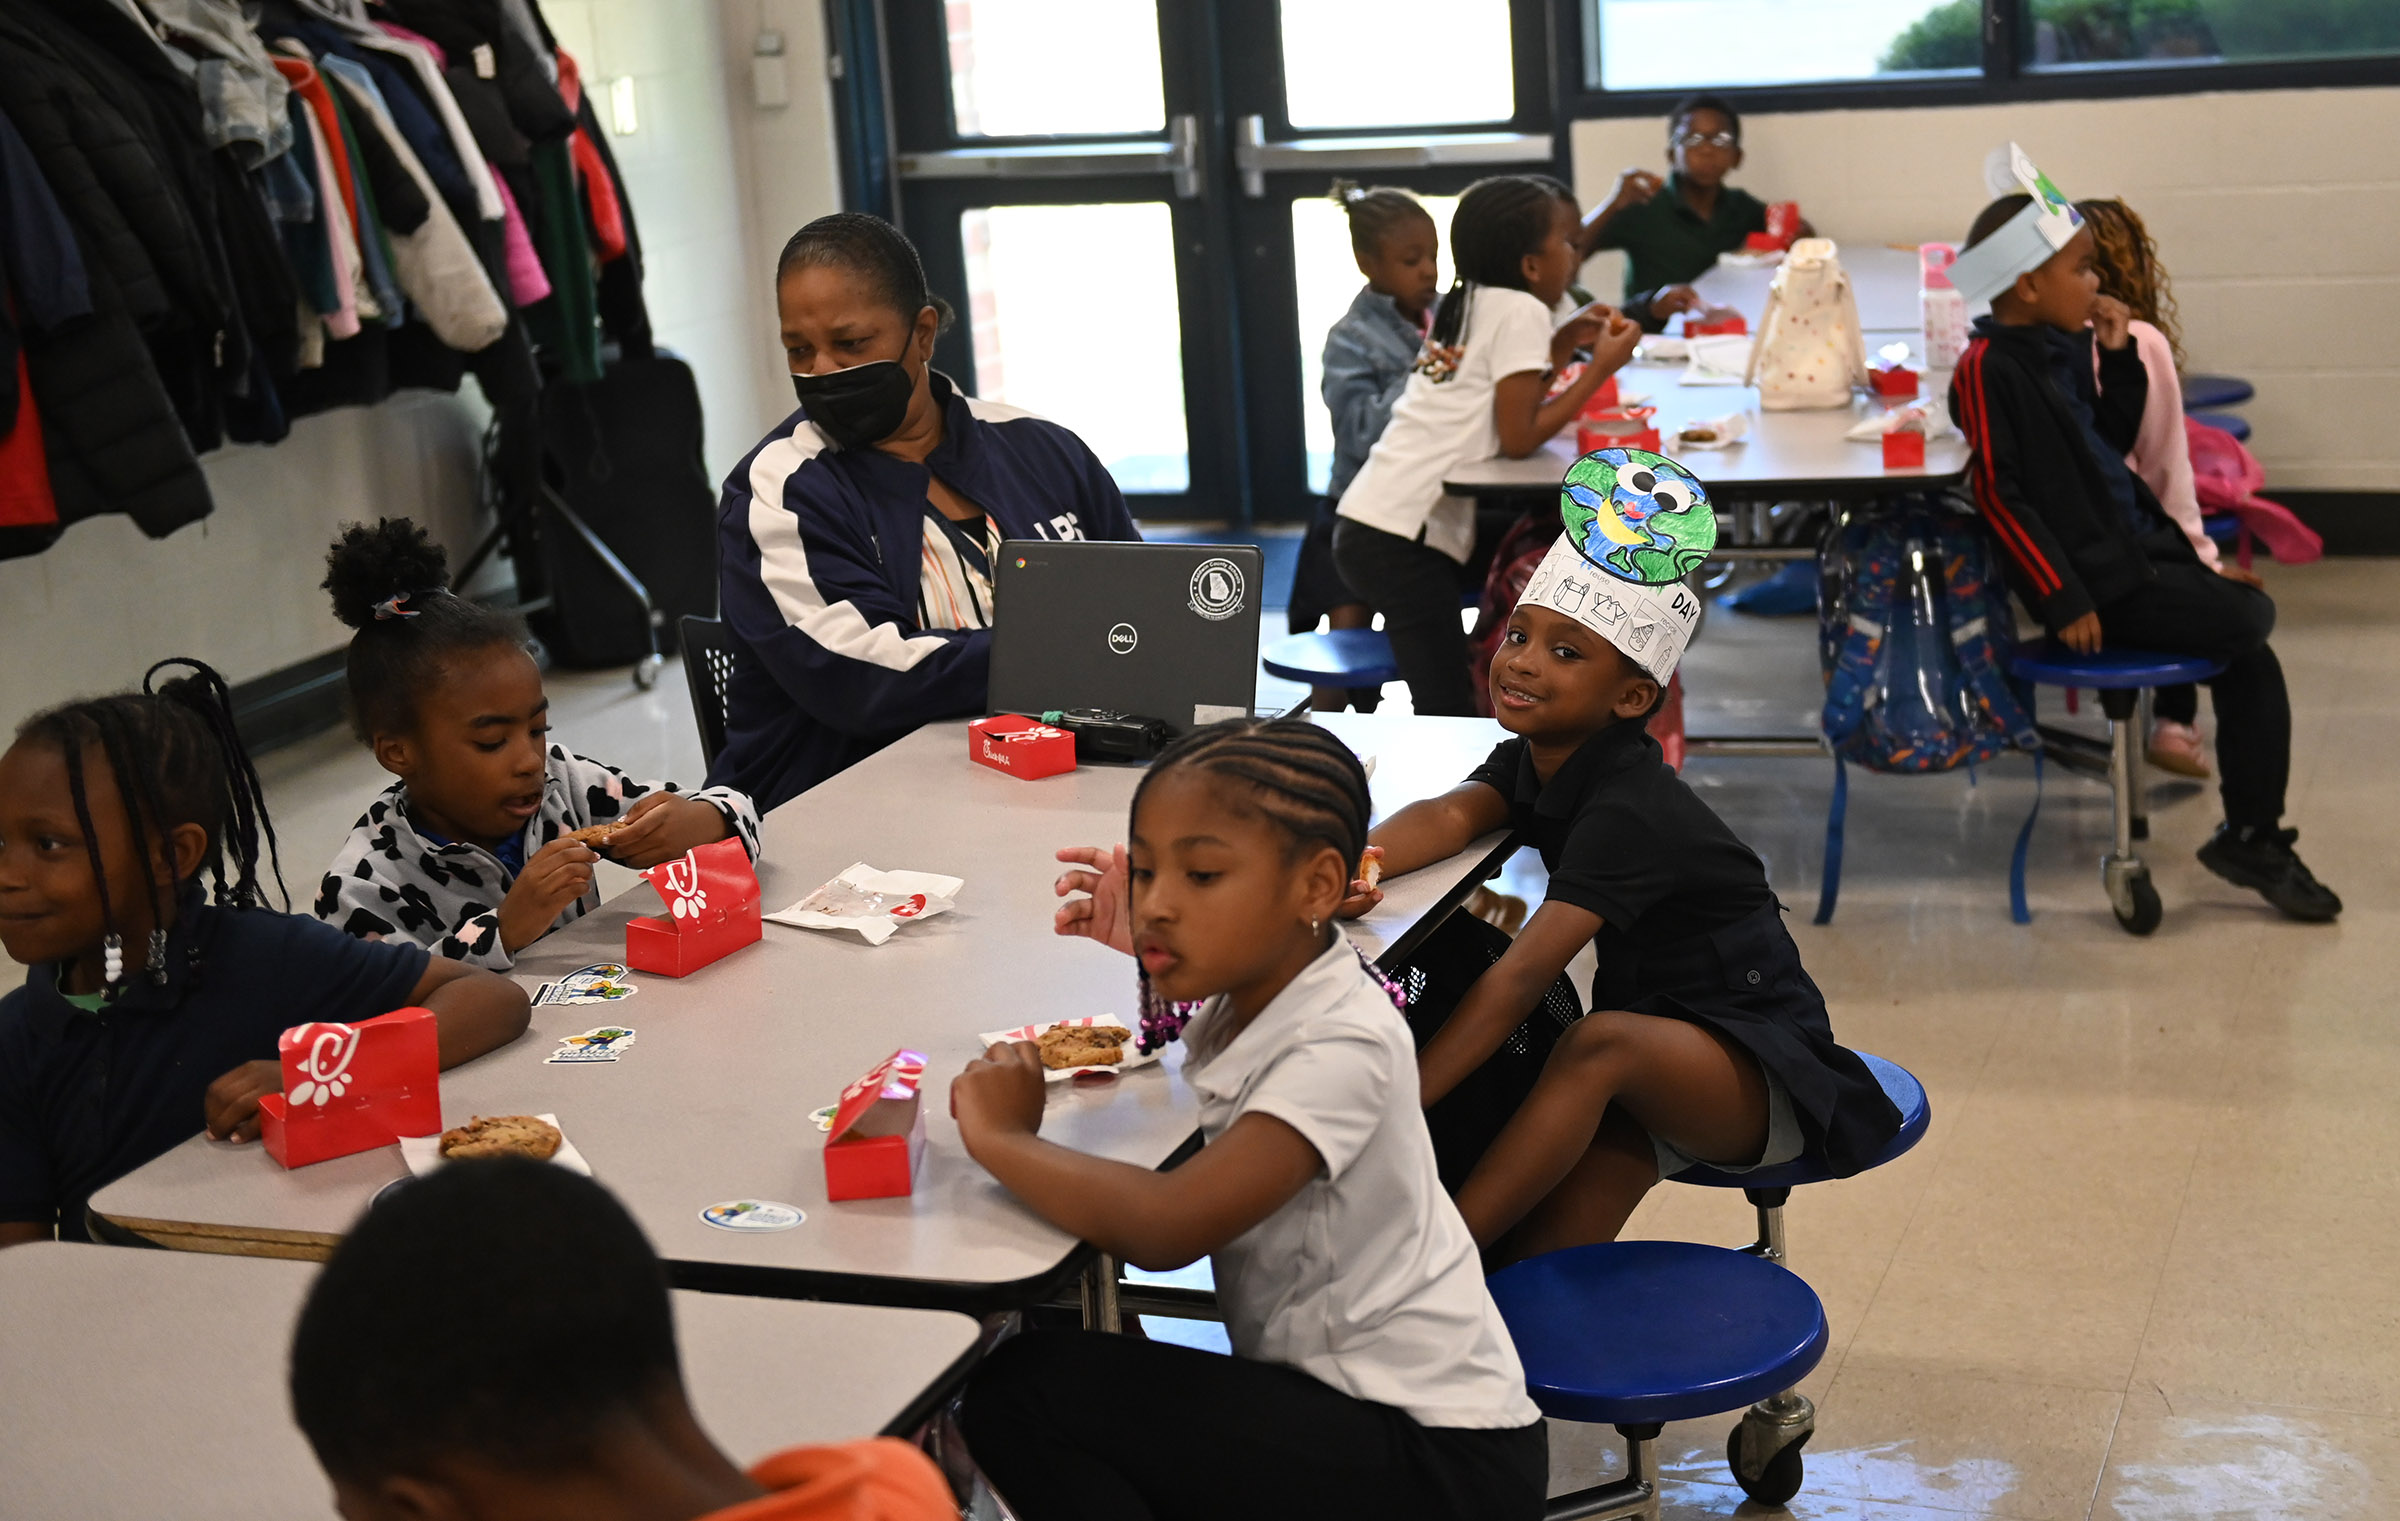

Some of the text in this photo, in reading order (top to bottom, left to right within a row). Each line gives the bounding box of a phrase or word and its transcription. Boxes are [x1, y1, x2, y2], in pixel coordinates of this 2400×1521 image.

[1209, 561, 1228, 569] County
[1590, 570, 1610, 586] reuse
[1671, 592, 1698, 624] DAY
[1112, 634, 1134, 643] DELL
